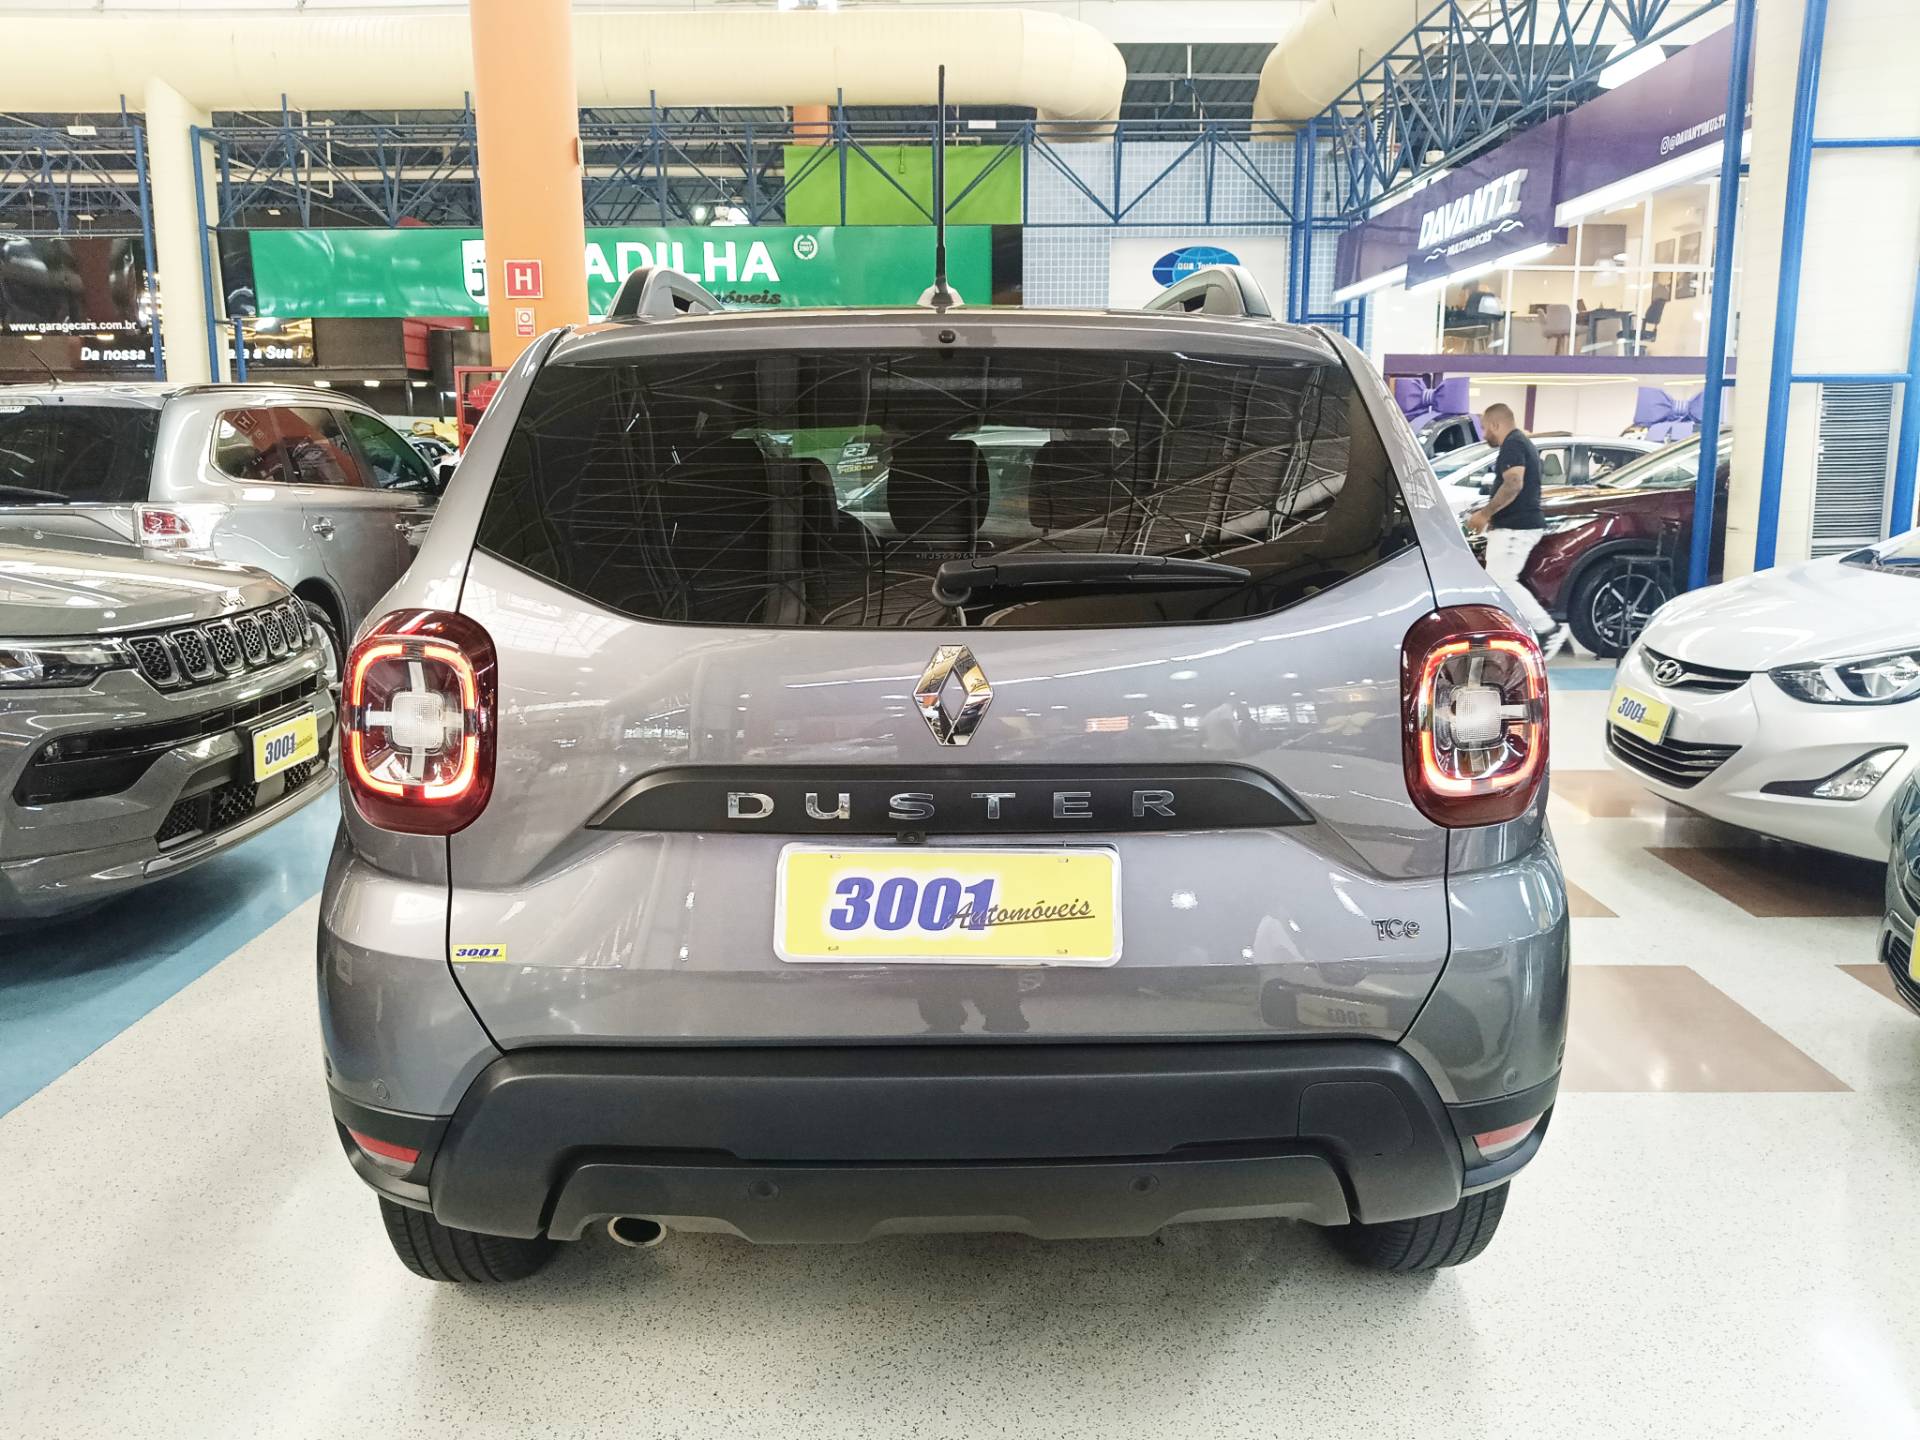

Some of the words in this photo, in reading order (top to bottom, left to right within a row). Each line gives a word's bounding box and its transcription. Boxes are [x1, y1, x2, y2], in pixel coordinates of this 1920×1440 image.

[1418, 168, 1528, 250] DAVANTI
[584, 241, 780, 283] ADILHA
[515, 268, 533, 290] H
[9, 320, 137, 333] www.garagecars.com.br
[81, 347, 100, 360] Da
[103, 348, 146, 360] nossa
[1617, 697, 1647, 723] 3001
[265, 732, 295, 765] 3001
[727, 791, 1176, 820] DUSTER
[829, 877, 995, 931] 3001
[944, 898, 1095, 929] Automóveis
[456, 948, 499, 957] 3001
